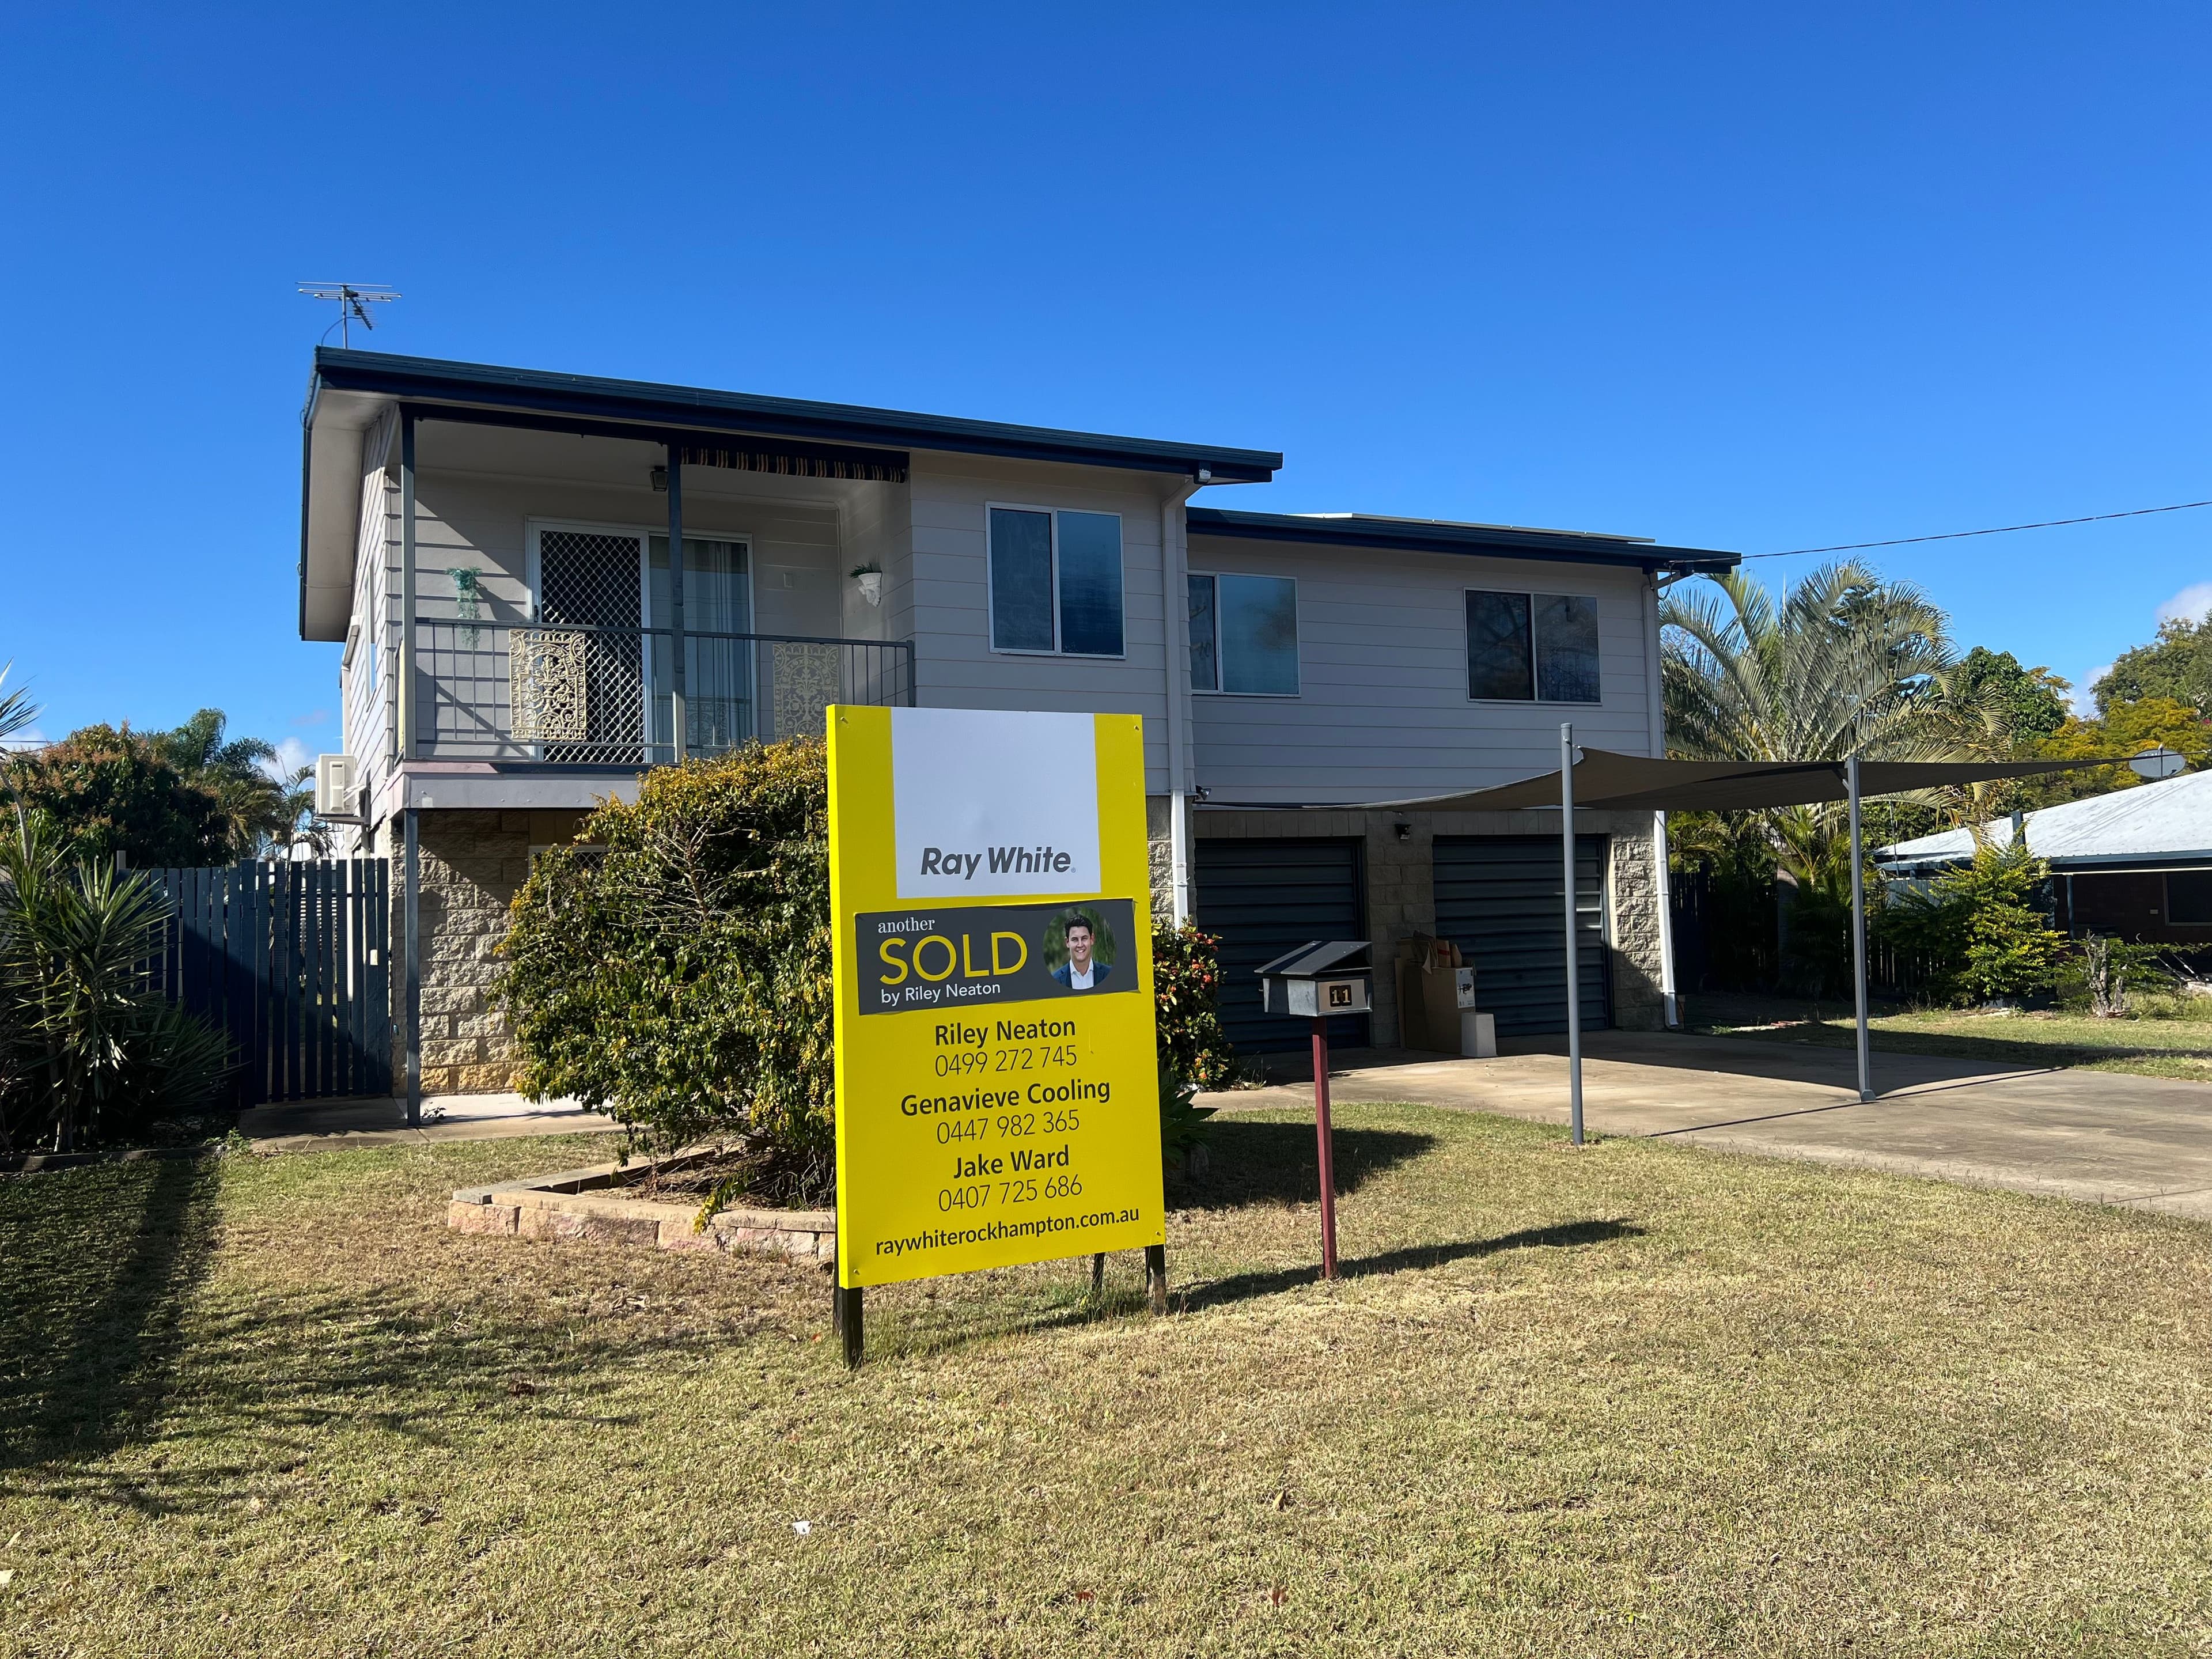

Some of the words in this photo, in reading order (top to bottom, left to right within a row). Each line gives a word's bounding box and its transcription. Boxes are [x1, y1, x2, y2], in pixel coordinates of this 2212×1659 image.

[921, 847, 982, 880] Ray
[987, 846, 1071, 874] White
[878, 916, 935, 934] another
[879, 931, 1028, 986] SOLD
[881, 988, 900, 1005] by
[905, 985, 942, 1002] Riley
[945, 982, 1001, 998] Neaton
[1332, 989, 1350, 1003] 11
[935, 1022, 989, 1048] Riley
[996, 1018, 1076, 1041] Neaton
[934, 1051, 988, 1077] 0499
[995, 1047, 1033, 1072] 272
[1039, 1044, 1077, 1068] 745
[900, 1088, 1020, 1116] Genavieve
[1027, 1078, 1111, 1104] Cooling
[936, 1118, 989, 1144] 0447
[997, 1113, 1036, 1138] 982
[1043, 1108, 1080, 1133] 365
[953, 1153, 1003, 1179] Jake
[1010, 1144, 1070, 1172] Ward
[938, 1184, 991, 1212] 0407
[999, 1179, 1038, 1205] 725
[1044, 1173, 1083, 1199] 686
[876, 1207, 1140, 1256] raywhiterockhampton.com.au
